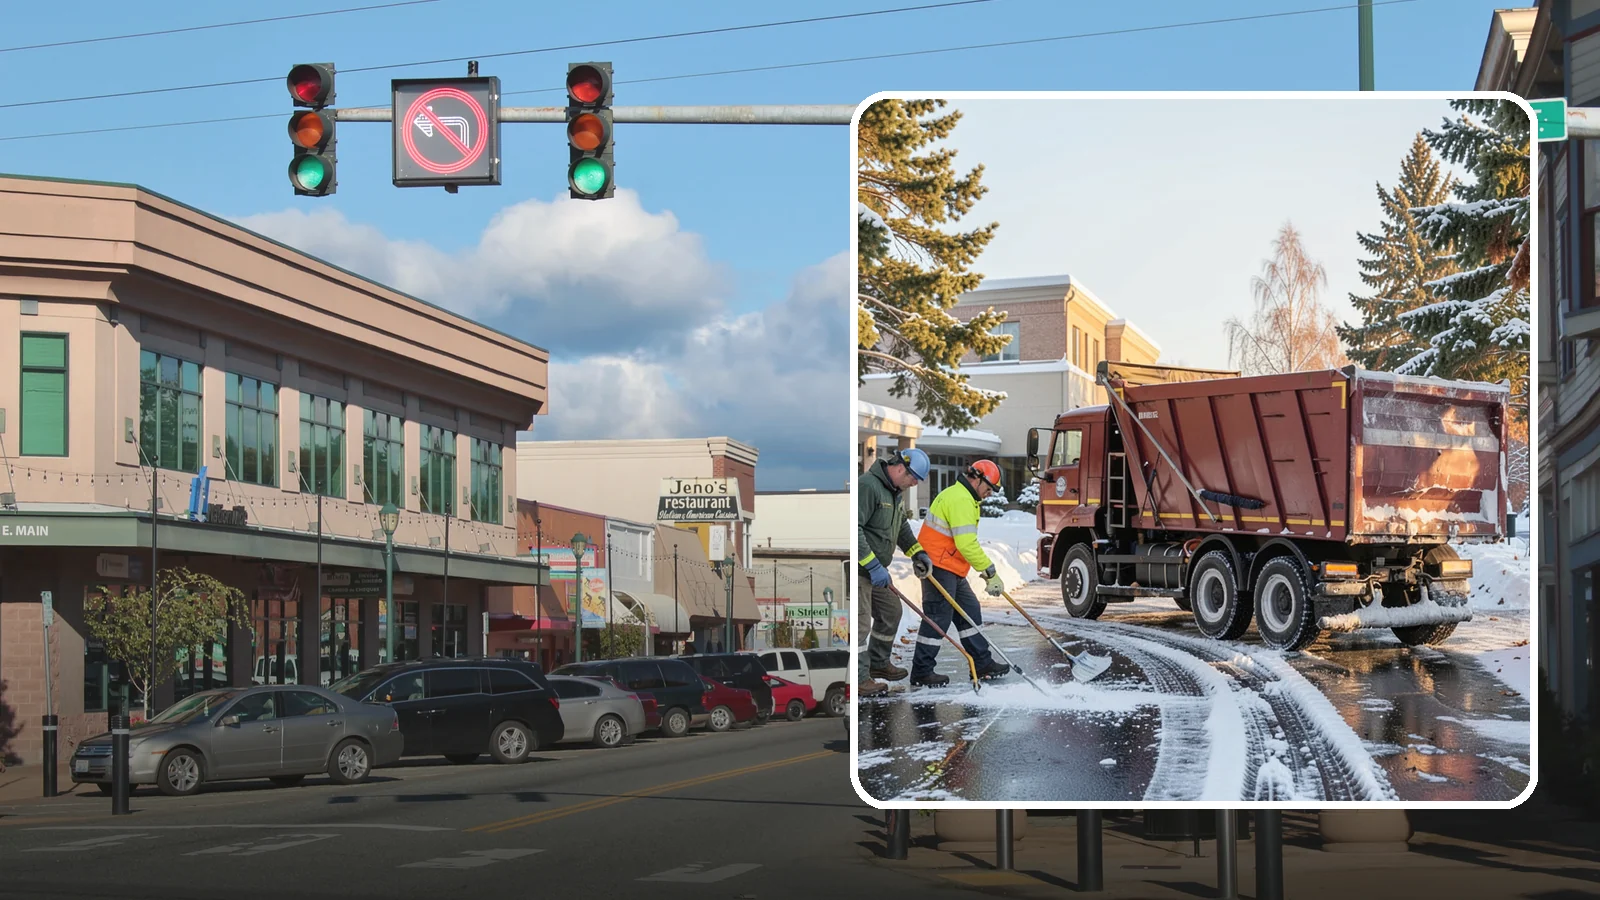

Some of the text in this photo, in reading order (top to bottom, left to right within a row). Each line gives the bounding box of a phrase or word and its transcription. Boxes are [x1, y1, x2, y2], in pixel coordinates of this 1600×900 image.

[670, 480, 727, 494] Jeno's
[665, 496, 731, 509] restaurant
[658, 510, 682, 519] Italian
[686, 510, 715, 519] American
[715, 510, 737, 519] Cuisine
[2, 525, 49, 537] E. MAIN
[797, 607, 828, 617] Street
